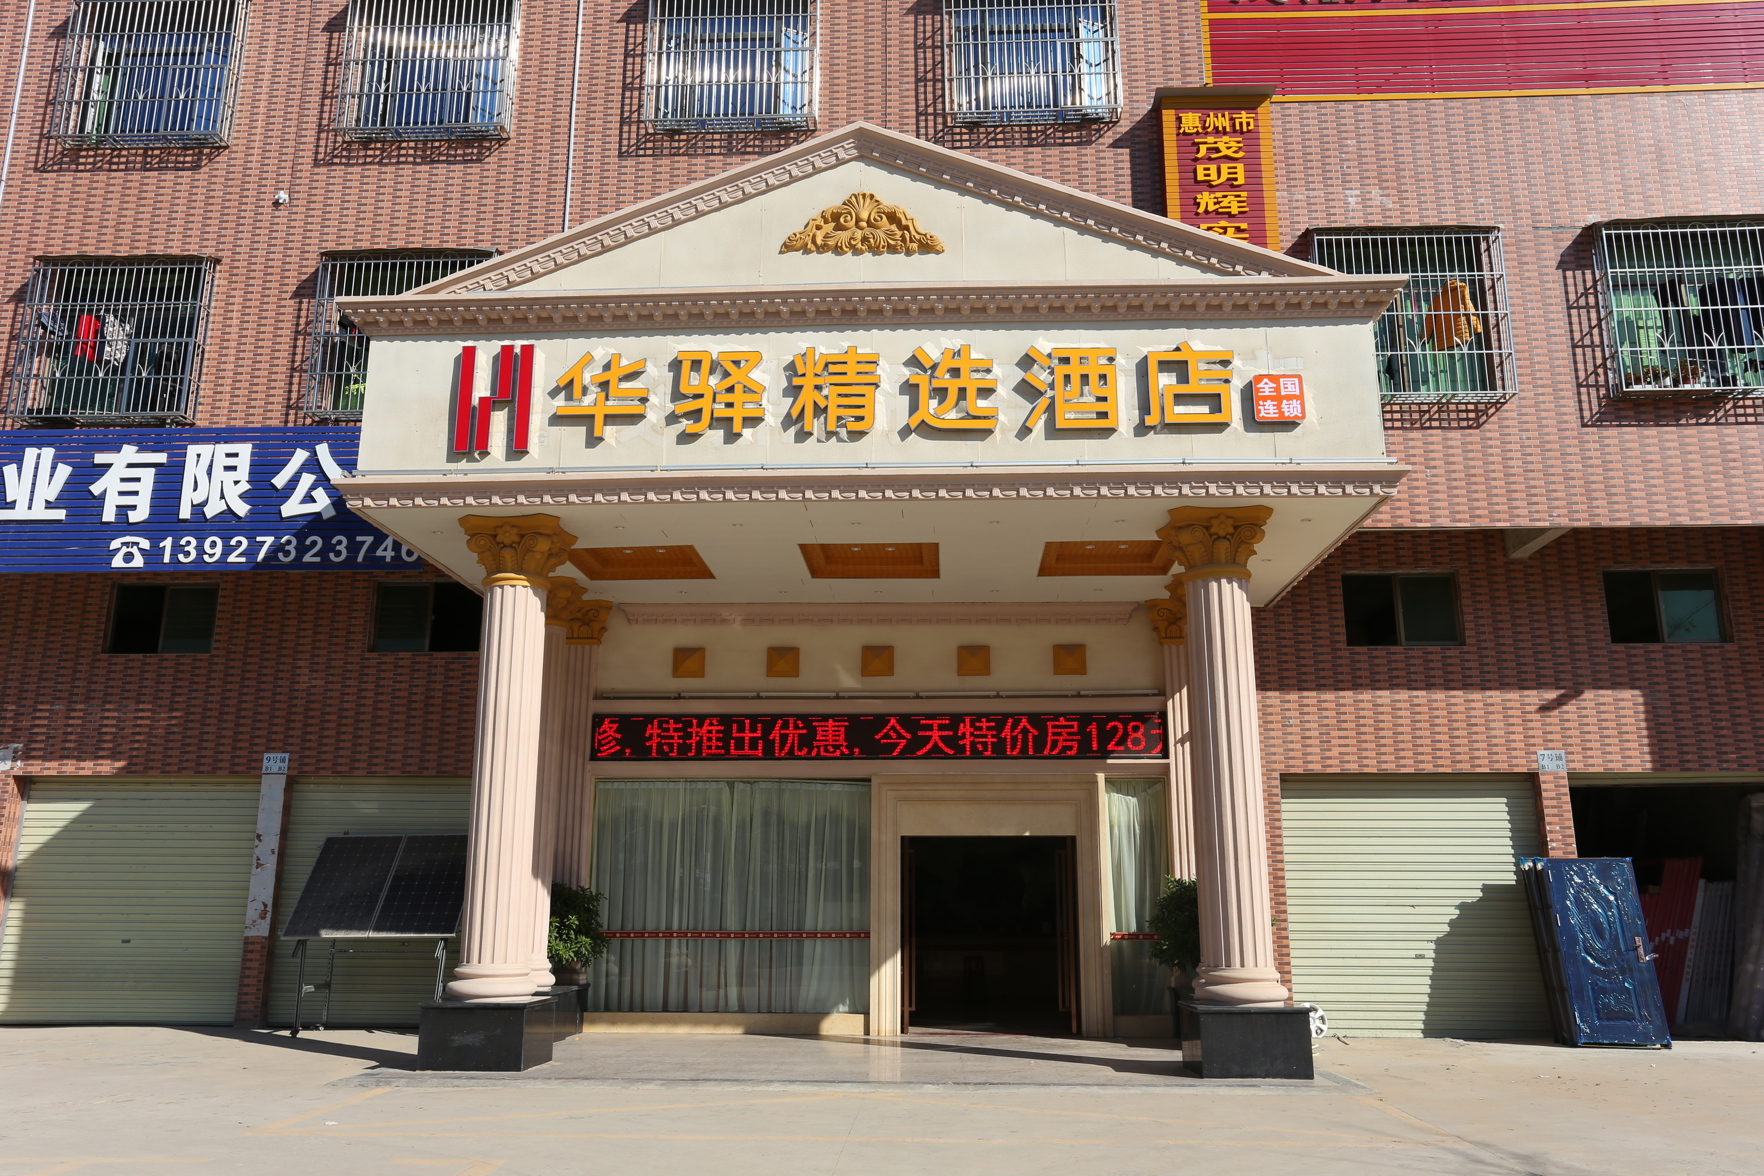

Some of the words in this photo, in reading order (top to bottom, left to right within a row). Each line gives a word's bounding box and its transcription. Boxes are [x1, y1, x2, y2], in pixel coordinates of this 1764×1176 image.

[1178, 111, 1256, 135] 惠州市
[555, 341, 1235, 438] 华驿精选酒店
[1256, 377, 1301, 396] 全国
[1257, 399, 1303, 418] 连锁
[0, 443, 344, 524] 业有限公
